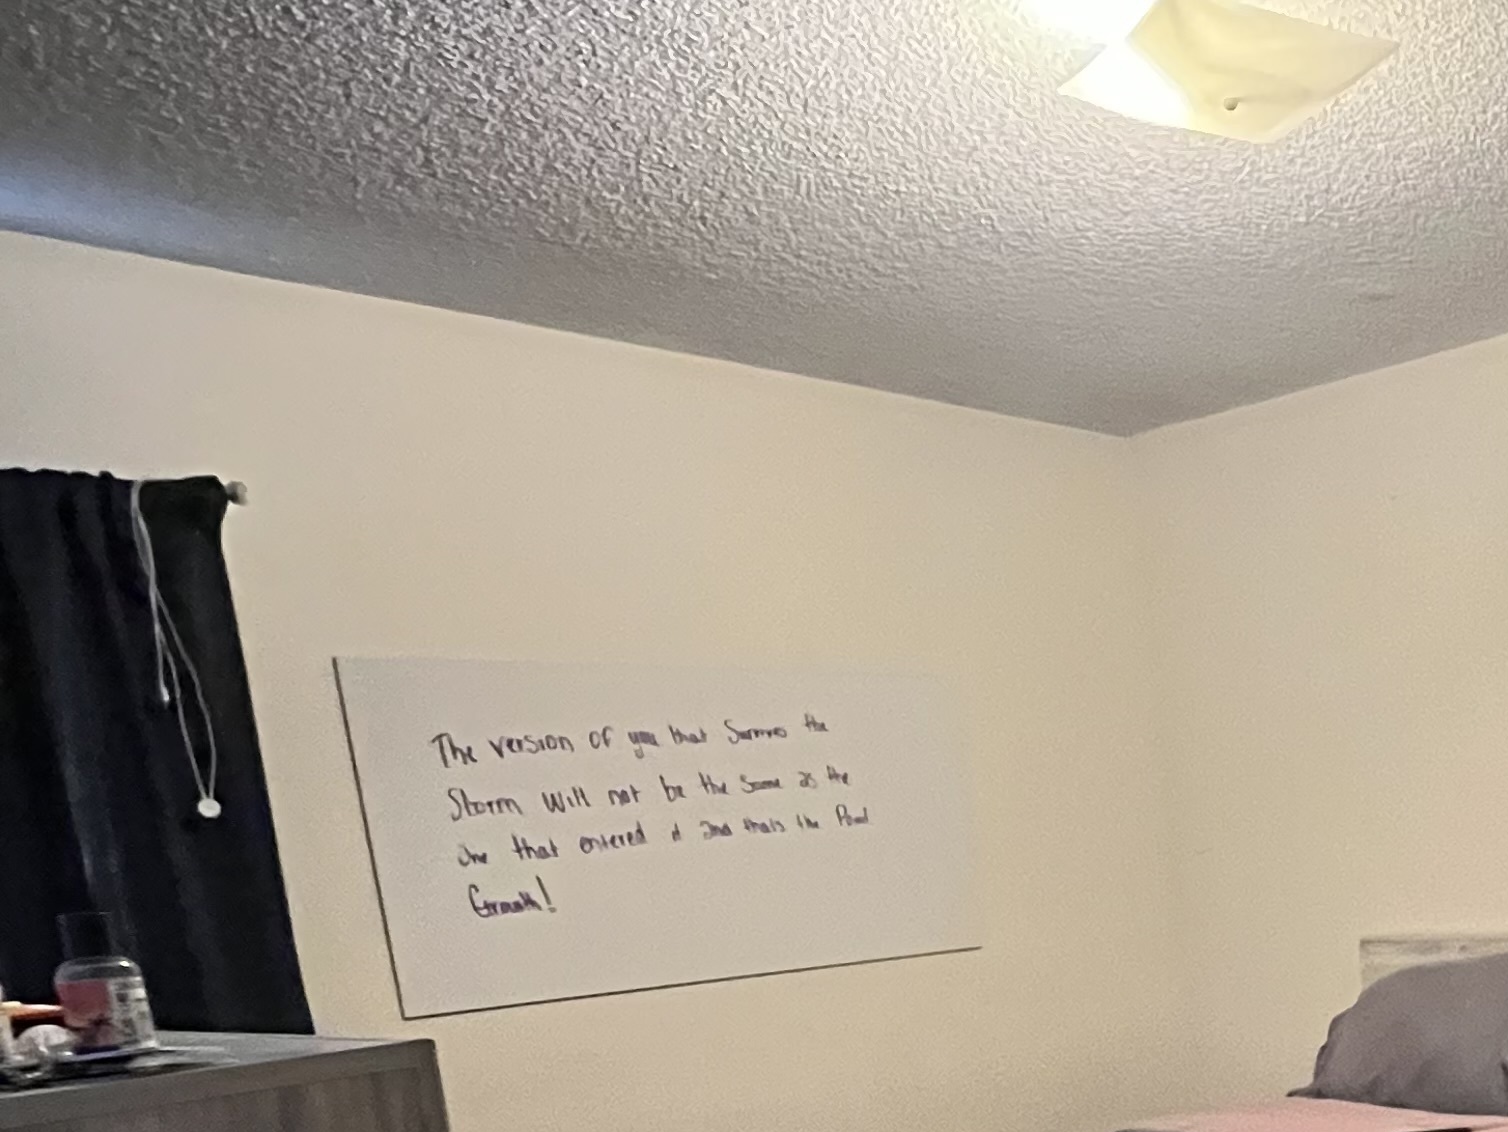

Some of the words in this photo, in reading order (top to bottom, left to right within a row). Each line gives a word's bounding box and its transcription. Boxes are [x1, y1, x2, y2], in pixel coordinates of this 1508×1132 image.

[431, 732, 478, 768] The
[488, 734, 575, 758] version
[628, 731, 659, 759] you
[668, 724, 707, 745] that
[804, 713, 828, 732] the
[608, 784, 640, 806] not
[659, 774, 687, 802] be
[698, 771, 729, 795] the
[826, 765, 850, 786] the
[511, 833, 559, 860] that
